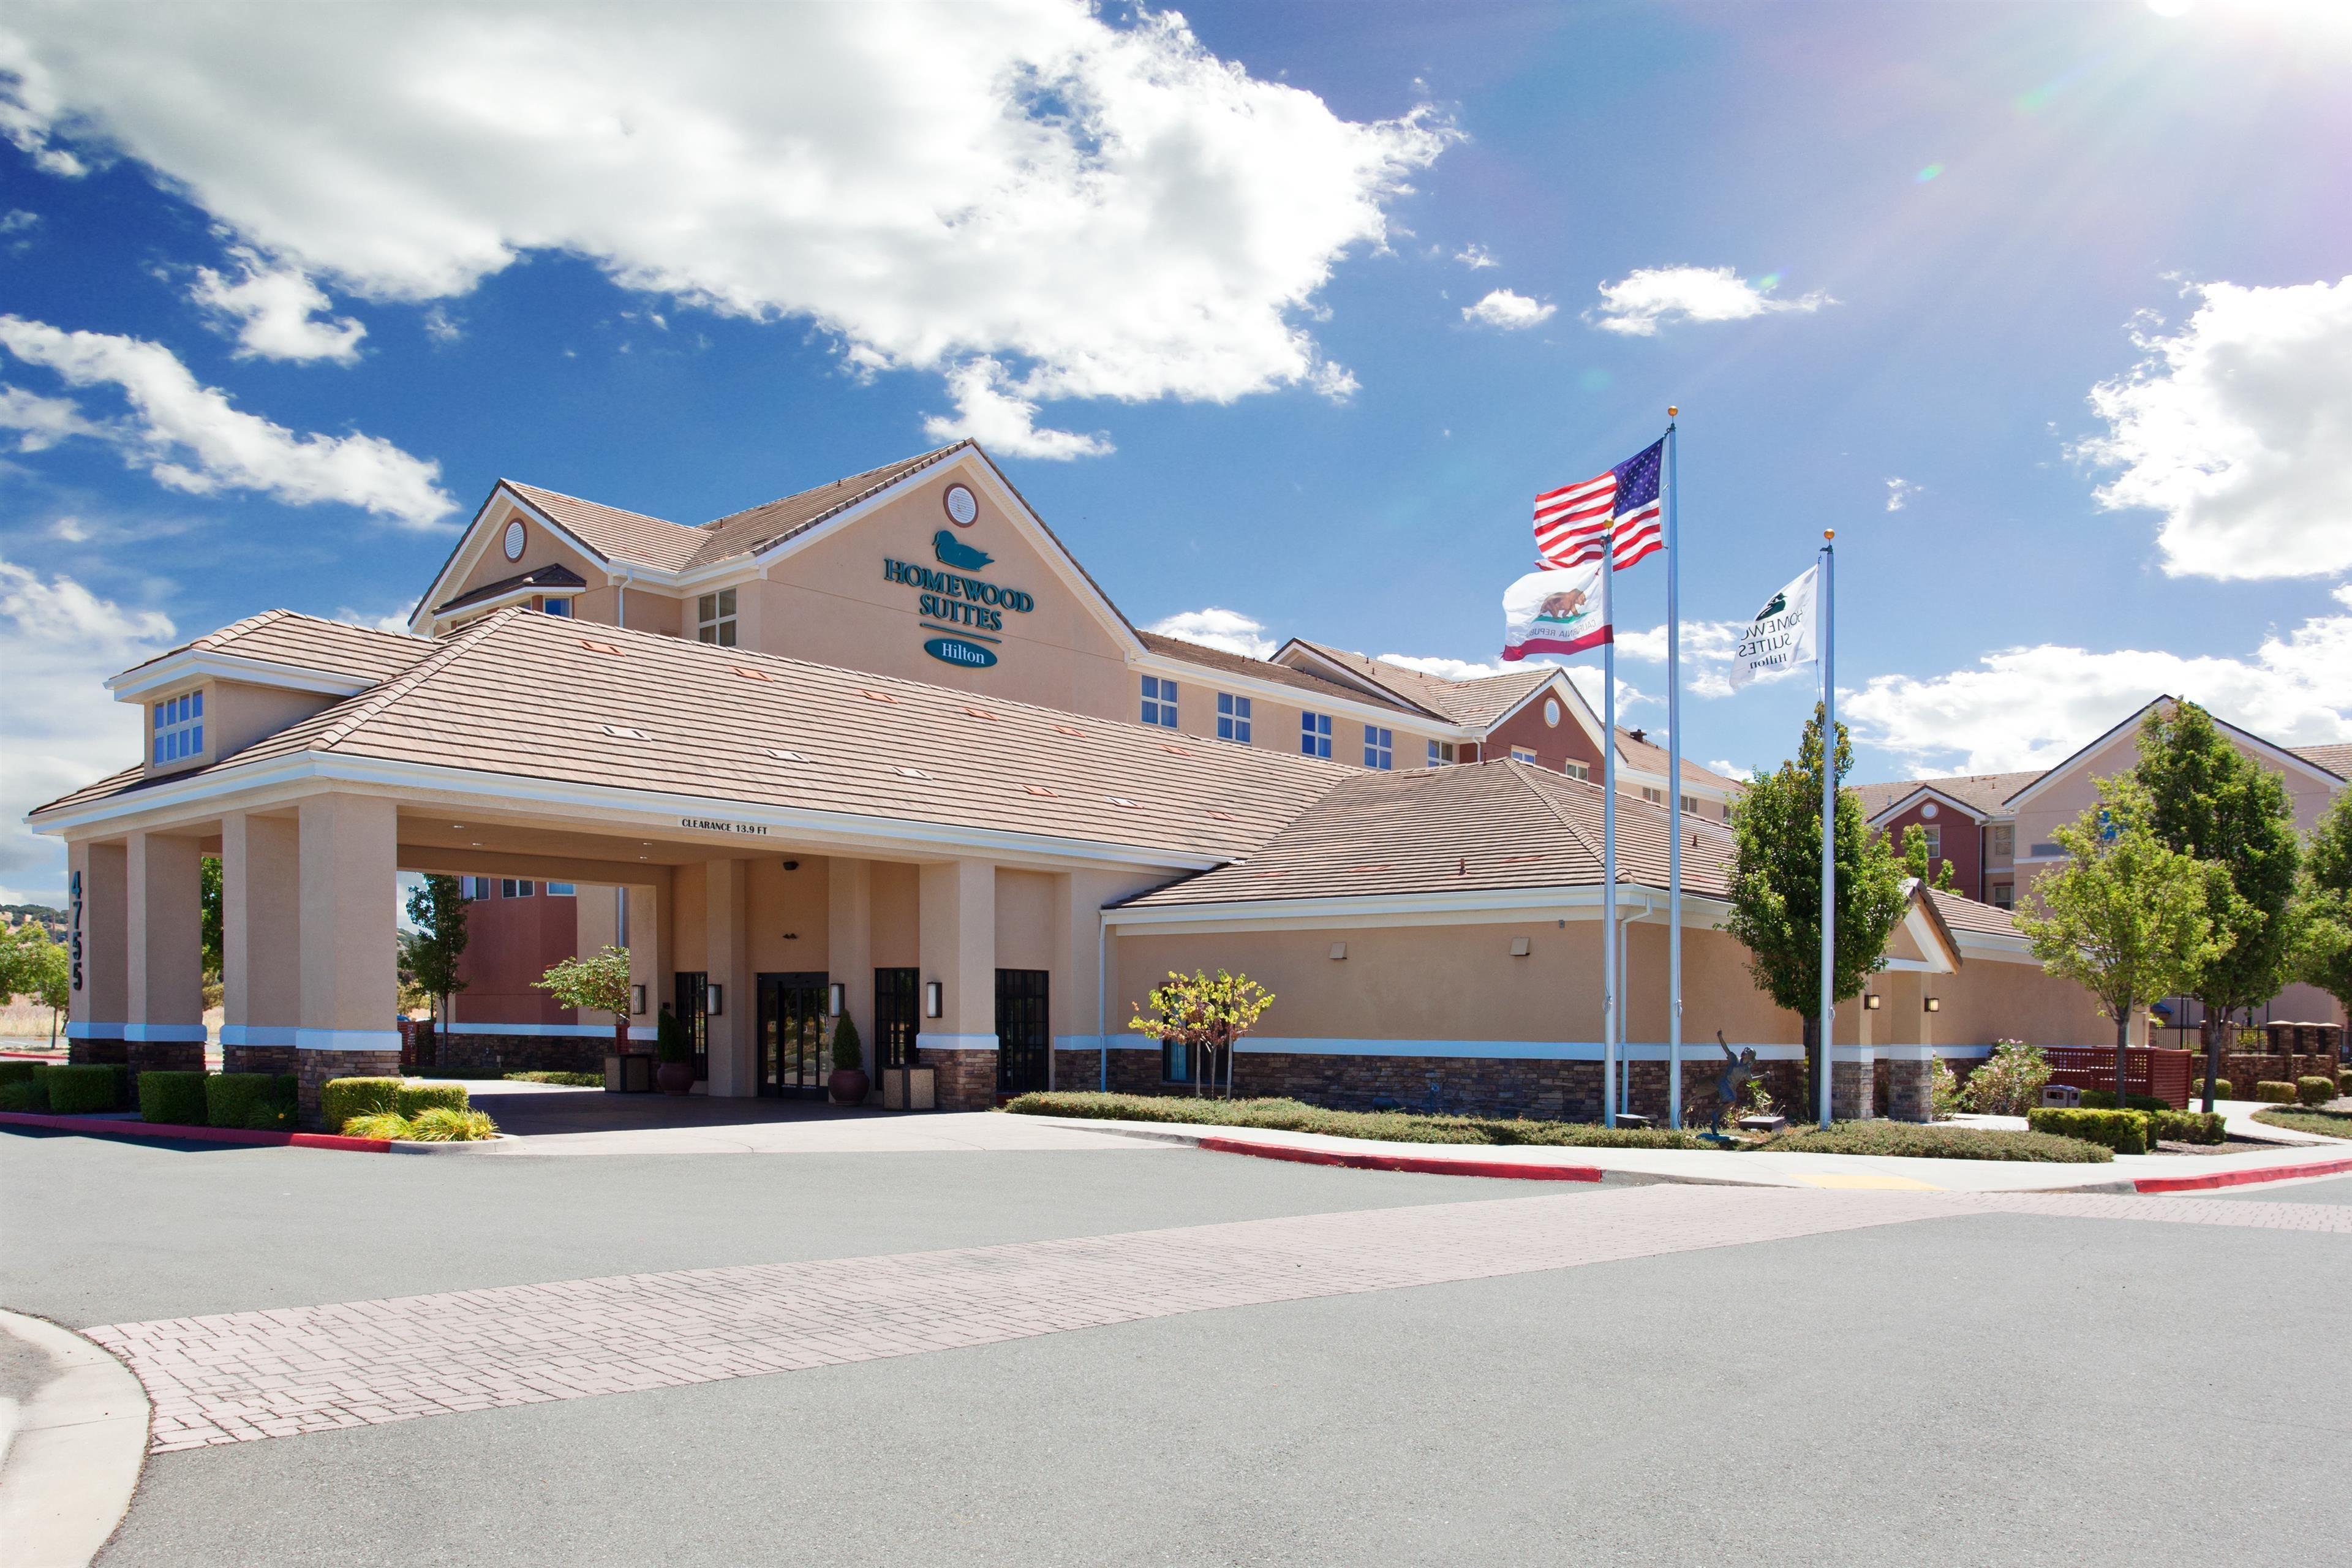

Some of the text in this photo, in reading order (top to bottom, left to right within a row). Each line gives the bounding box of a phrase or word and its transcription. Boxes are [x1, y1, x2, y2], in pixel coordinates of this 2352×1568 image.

[884, 559, 1034, 612] HOMEWOOD
[919, 594, 1002, 631] SUITES
[941, 643, 985, 664] Hilton
[682, 818, 731, 832] CLEARANCE
[736, 824, 754, 834] 13.9
[72, 870, 83, 991] 4755
